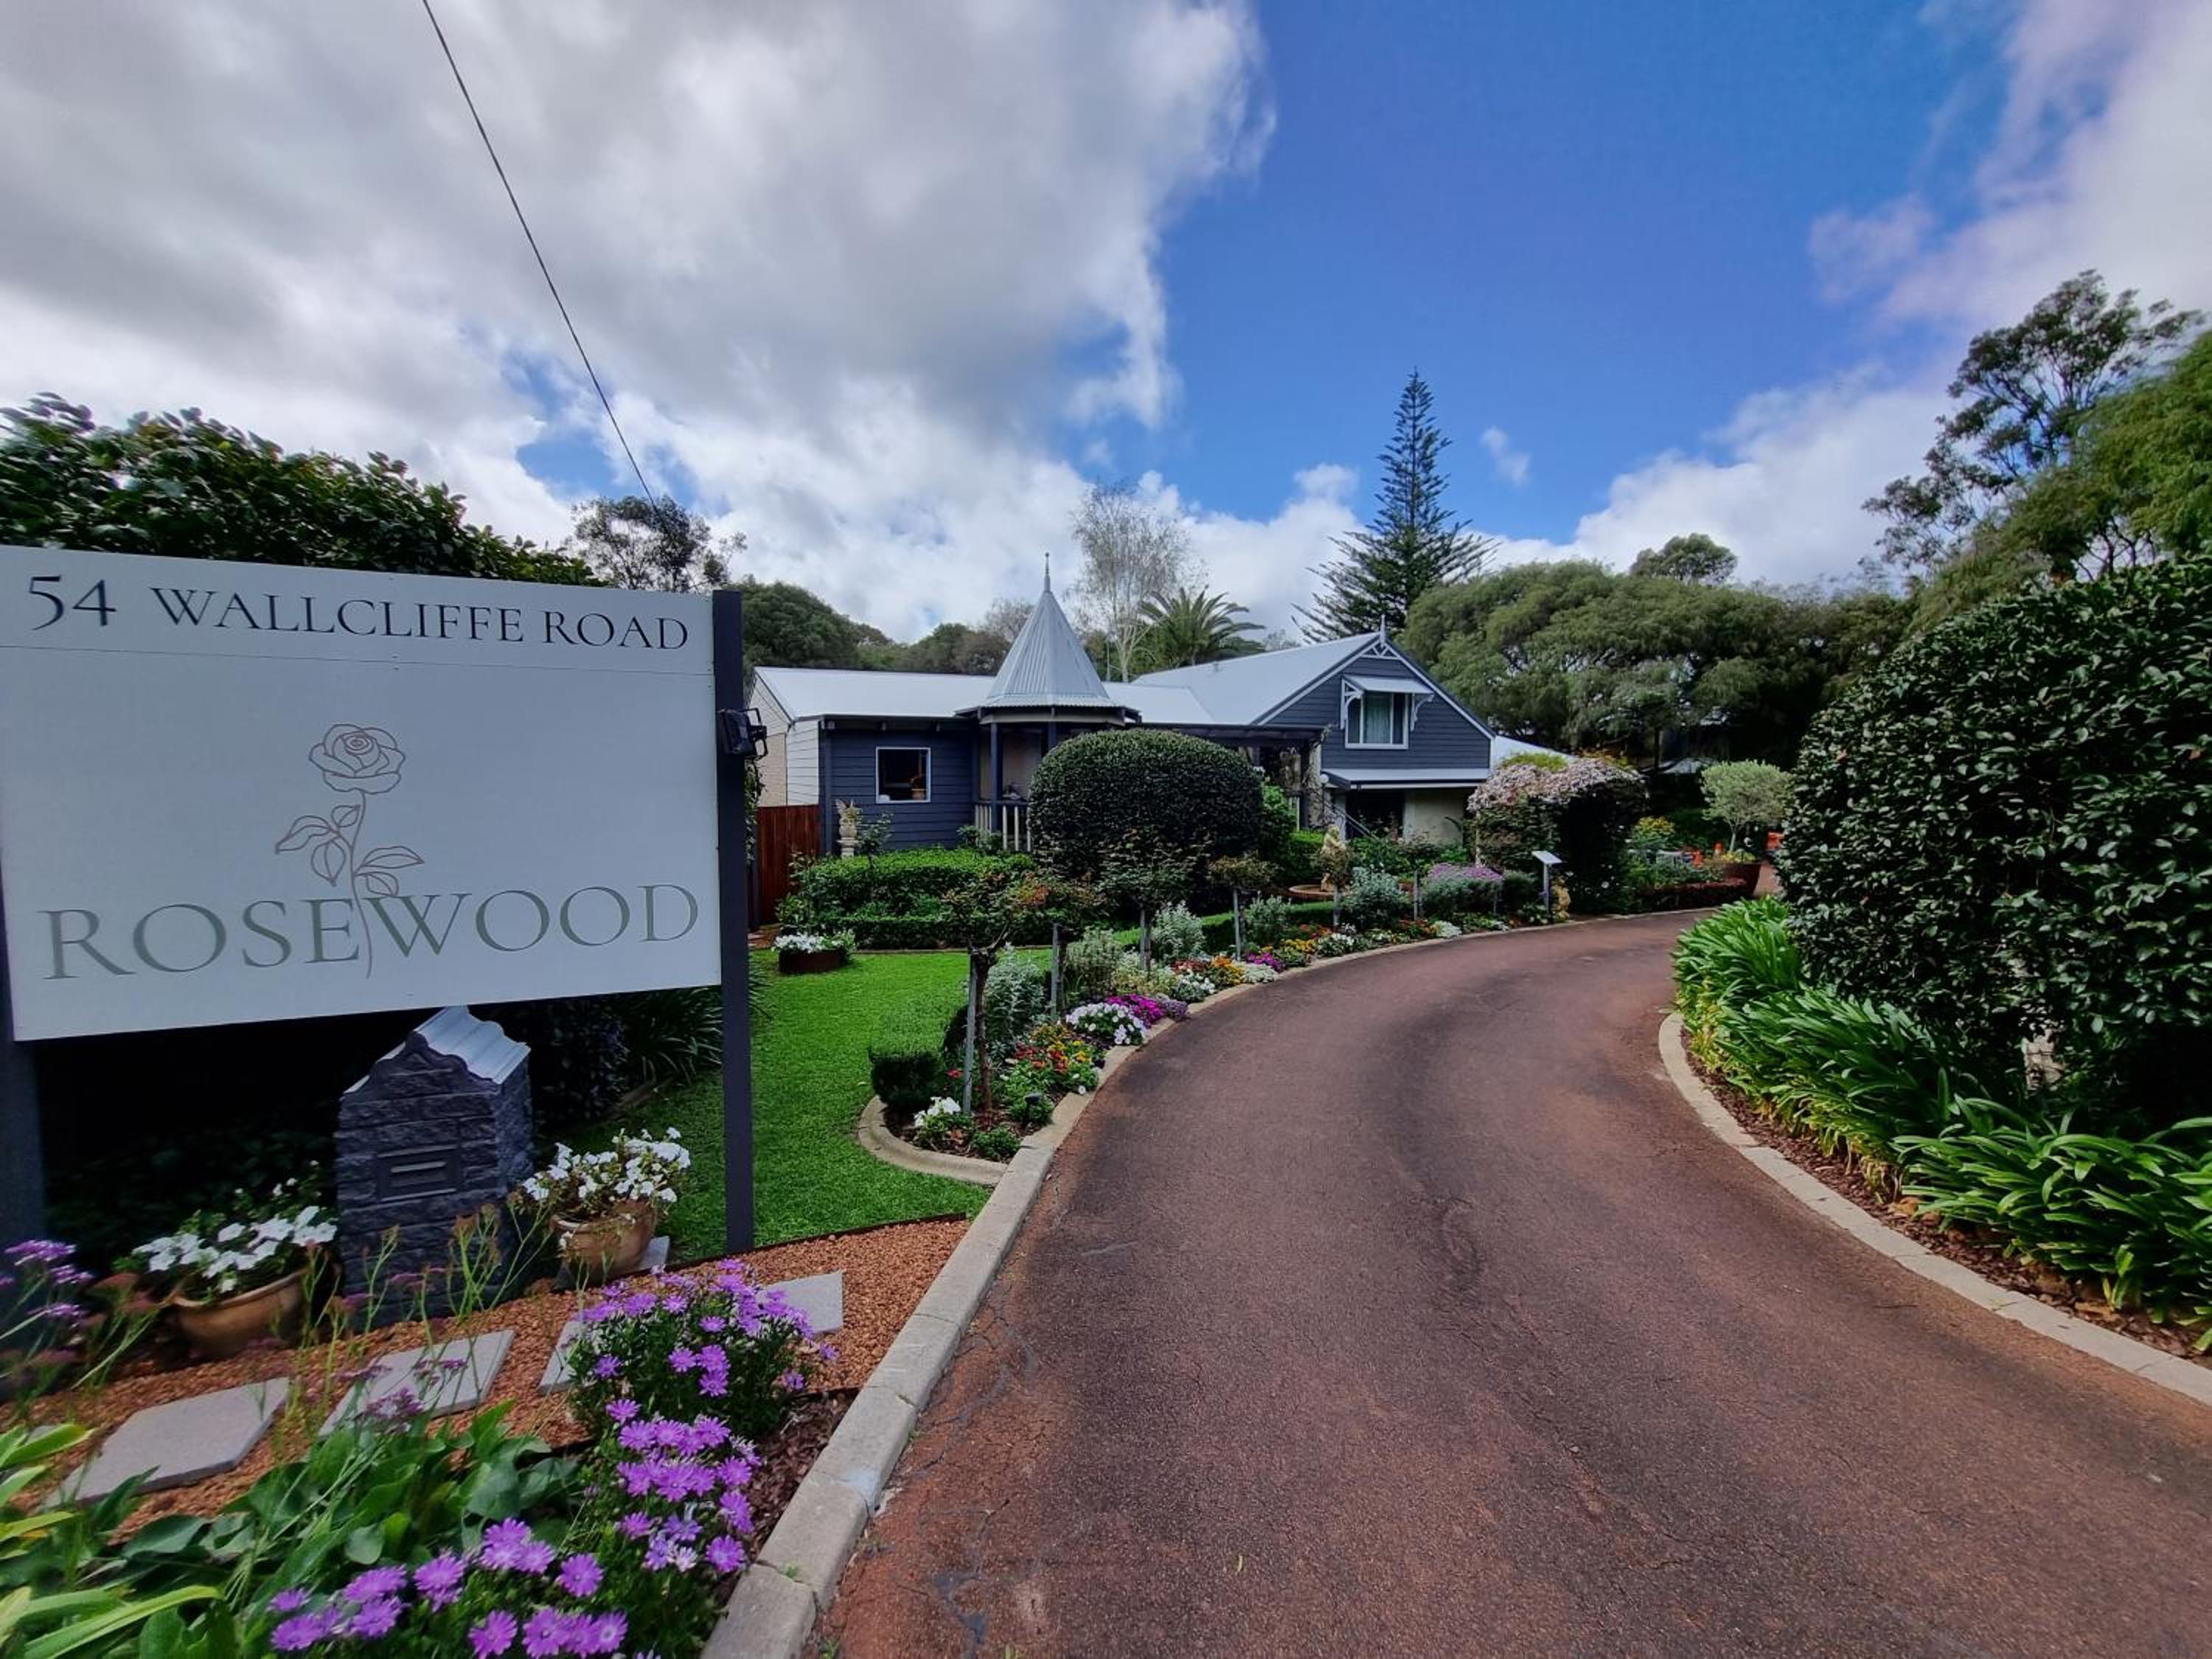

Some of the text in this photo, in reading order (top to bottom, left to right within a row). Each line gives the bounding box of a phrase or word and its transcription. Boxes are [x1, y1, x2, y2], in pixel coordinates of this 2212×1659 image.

[29, 575, 689, 650] 54 WALLCLIFFE ROAD
[37, 883, 700, 980] ROSEWOOD
